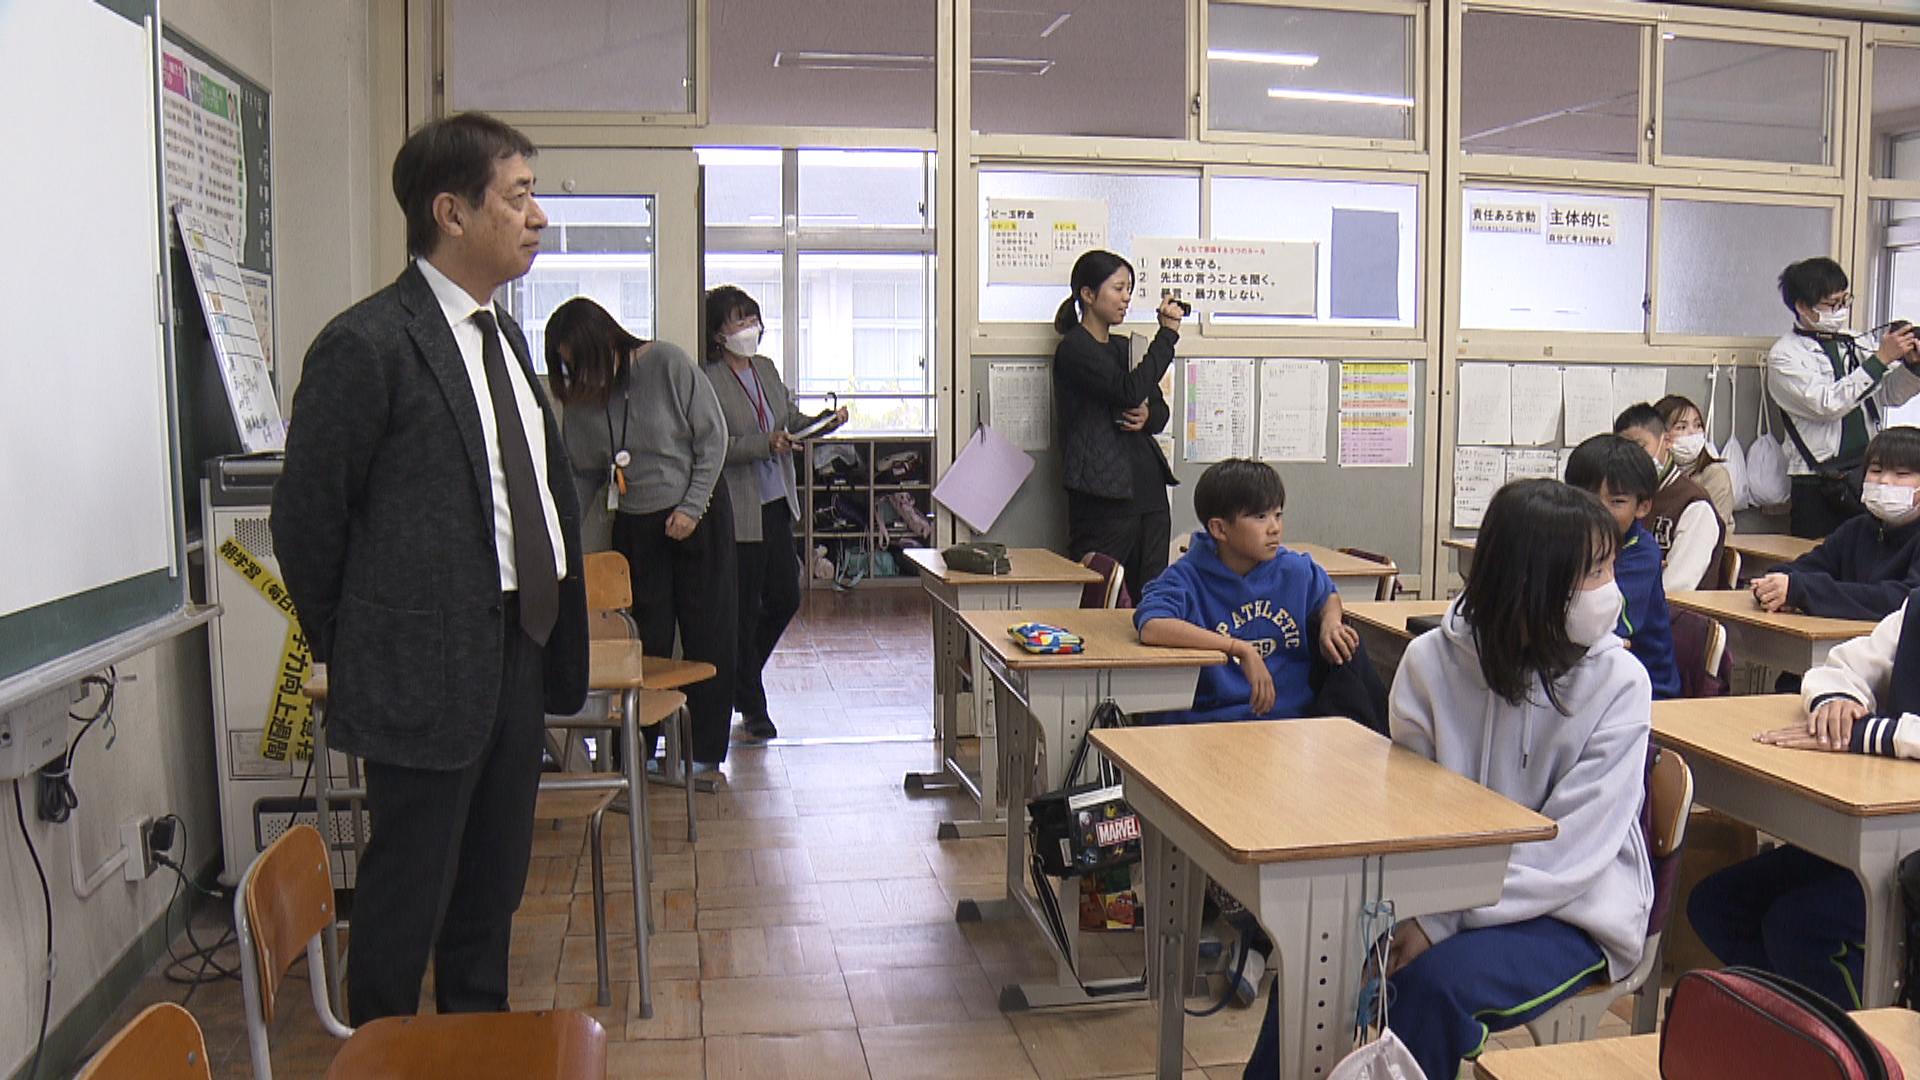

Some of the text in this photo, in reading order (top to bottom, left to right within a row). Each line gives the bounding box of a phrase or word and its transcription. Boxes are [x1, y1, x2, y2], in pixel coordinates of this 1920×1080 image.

[991, 210, 1035, 219] ビー玉貯金
[1473, 208, 1537, 224] 責任ある言動
[1549, 208, 1611, 228] 主体的に
[1160, 258, 1222, 271] 約束を守る。
[1160, 272, 1276, 287] 先生の言うことを聞く。
[1231, 600, 1300, 649] ATHLETIC
[1098, 817, 1139, 844] MARVEL
